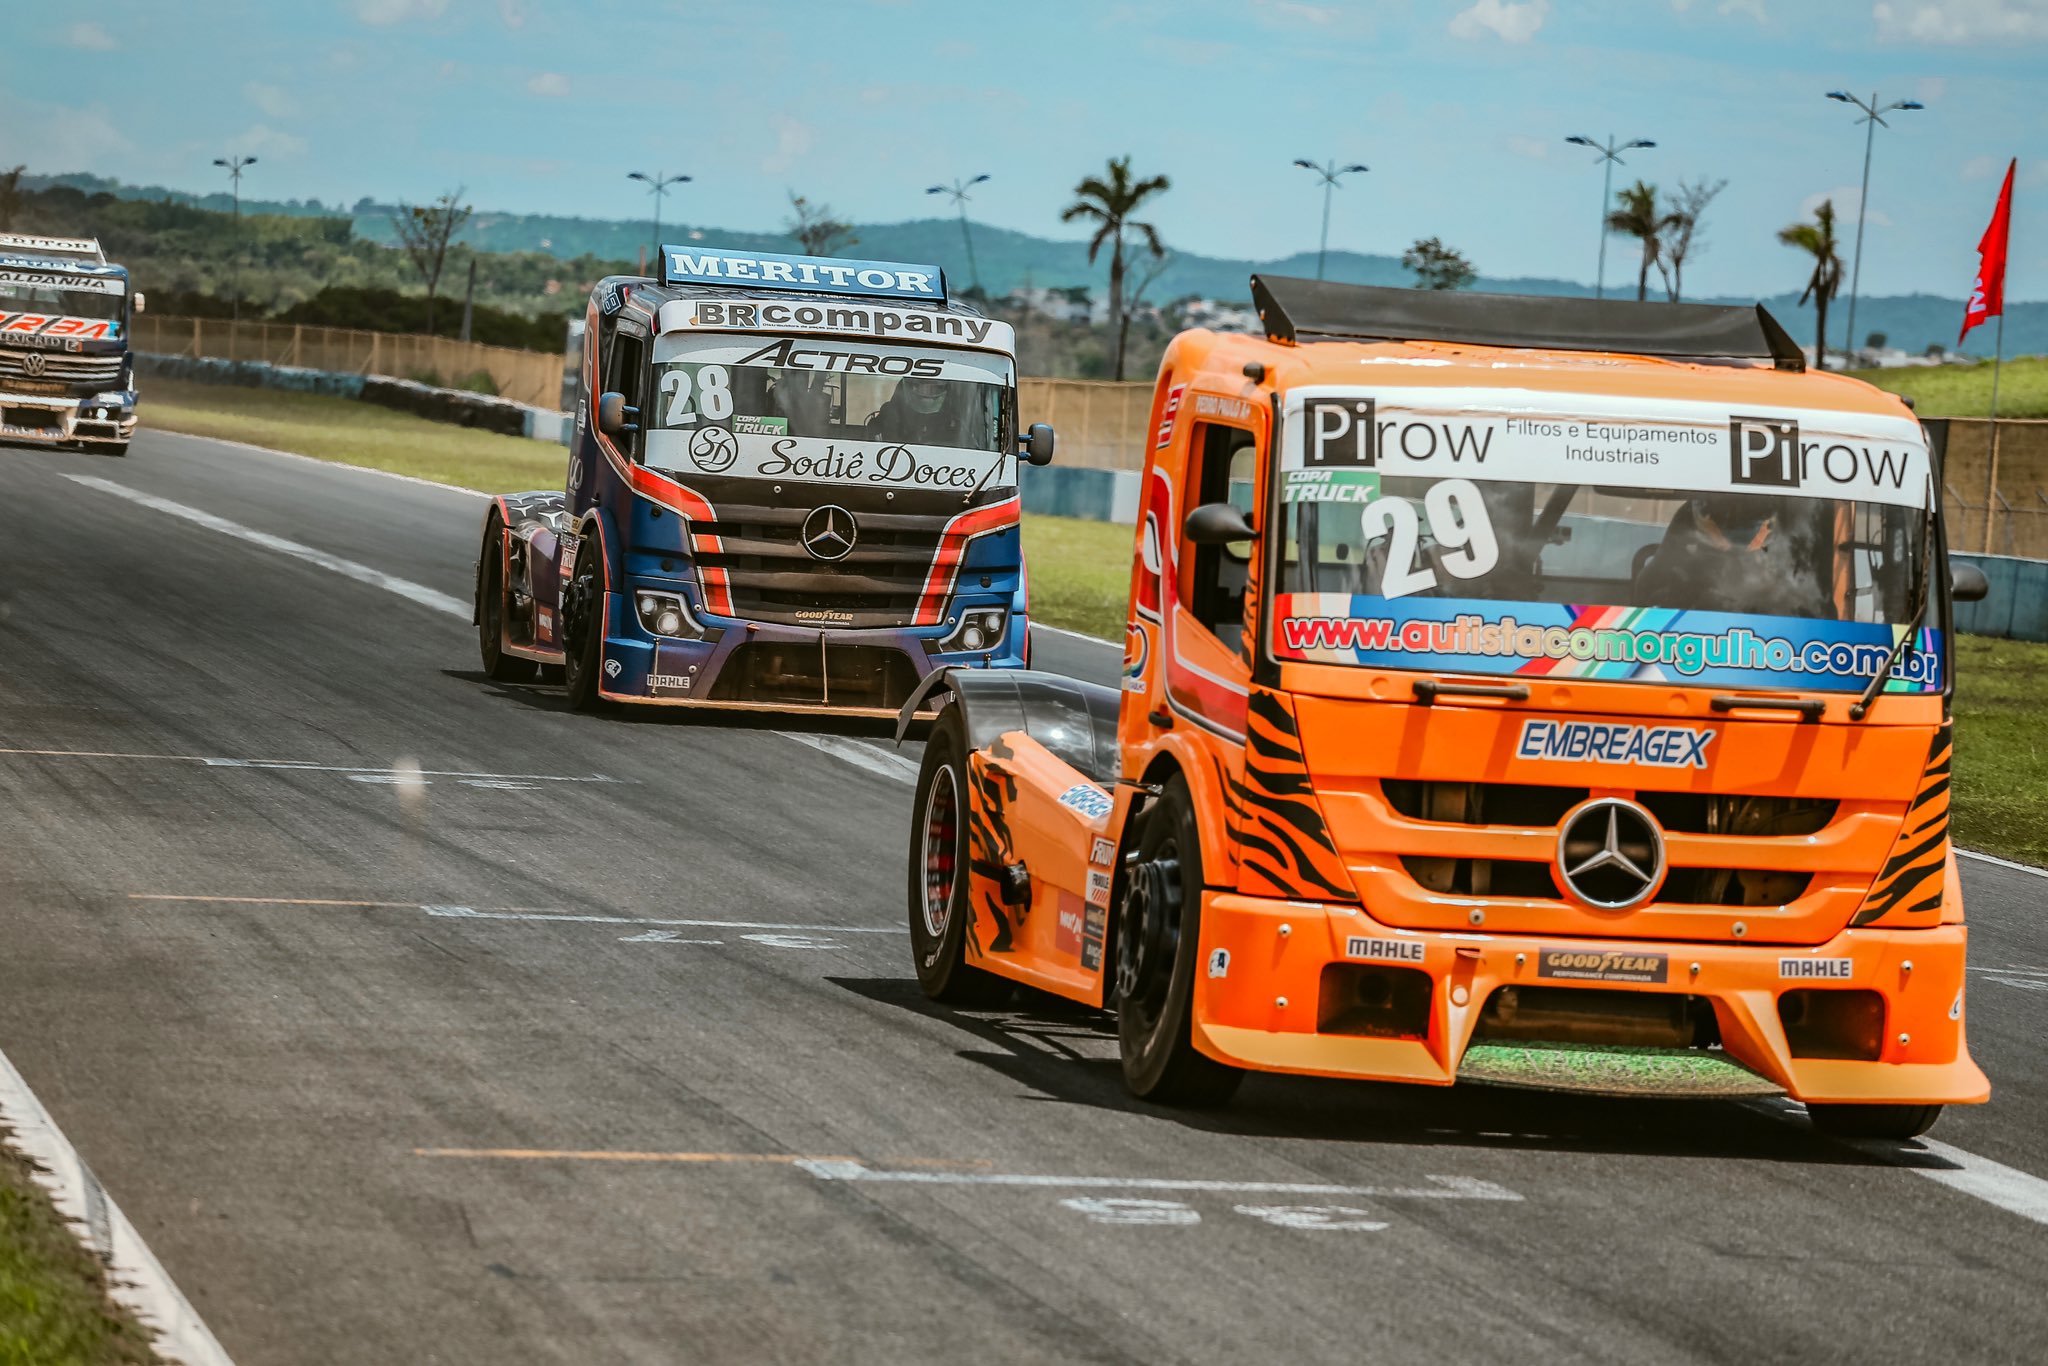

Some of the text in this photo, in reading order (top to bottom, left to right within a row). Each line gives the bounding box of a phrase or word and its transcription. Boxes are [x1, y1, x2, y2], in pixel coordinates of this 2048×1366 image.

[670, 253, 933, 293] MERITOR
[734, 339, 945, 377] ACTROS
[660, 364, 734, 427] 28
[735, 423, 784, 436] TRUCK
[736, 415, 761, 423] COPA
[1506, 418, 1718, 445] Filtros e Equipamentos
[1314, 401, 1494, 463] Pirow
[757, 439, 977, 488] Sodiê Doces
[1566, 445, 1659, 465] Industriais
[1740, 423, 1908, 489] Pirow
[1288, 471, 1332, 482] COPA
[1284, 485, 1375, 502] TRUCK
[1361, 479, 1499, 601] 29
[795, 610, 854, 621] GOODYEAR
[1283, 615, 1938, 684] www.autistacomorgulho.com.br
[648, 675, 689, 687] MAHLE
[1520, 722, 1712, 766] EMBREAGEX
[1349, 938, 1423, 961] MAHLE
[1547, 952, 1660, 971] GOODYEAR
[1781, 960, 1850, 978] MAHLE
